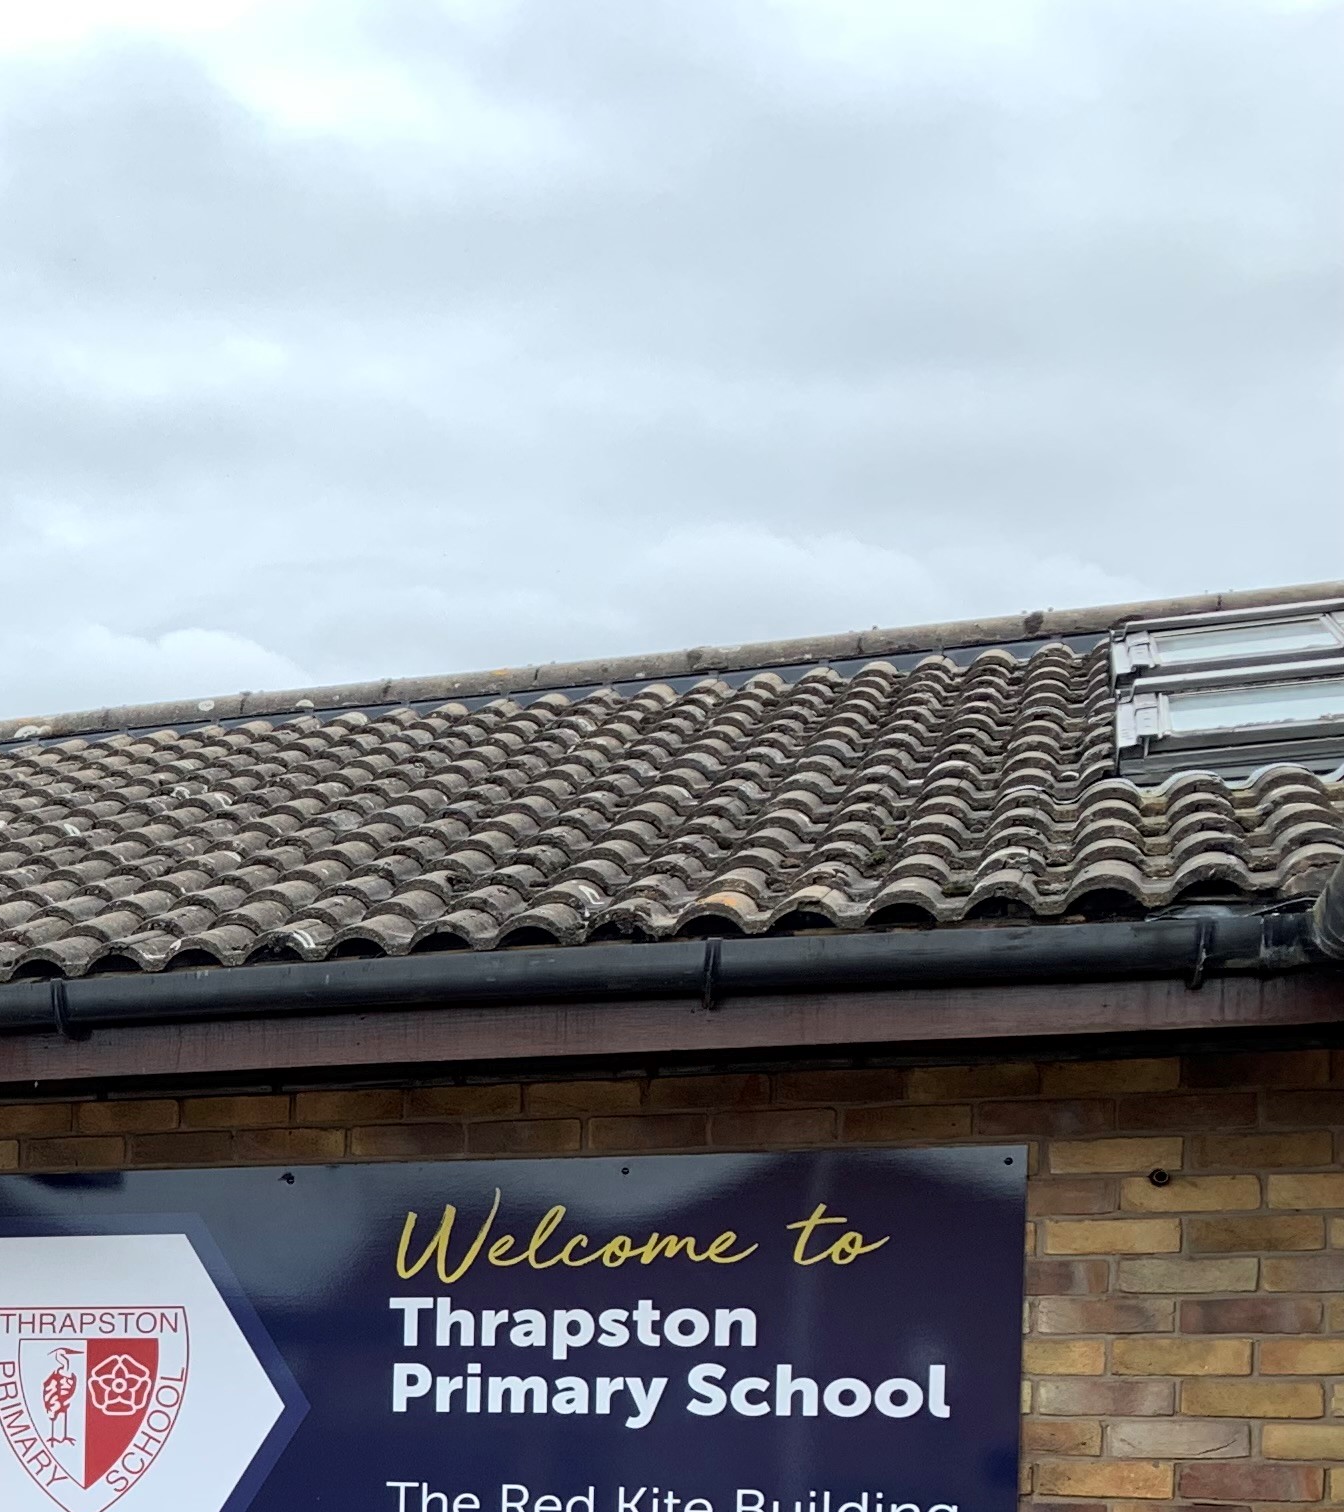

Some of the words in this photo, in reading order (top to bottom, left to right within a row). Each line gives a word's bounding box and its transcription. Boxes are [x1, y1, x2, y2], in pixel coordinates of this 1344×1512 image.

[395, 1187, 759, 1284] Welcome
[786, 1203, 891, 1266] to
[0, 1311, 179, 1335] THRAPSTON
[389, 1296, 758, 1360] Thrapston
[392, 1362, 669, 1429] Primary
[685, 1362, 951, 1418] School
[105, 1366, 185, 1493] SCHOOL
